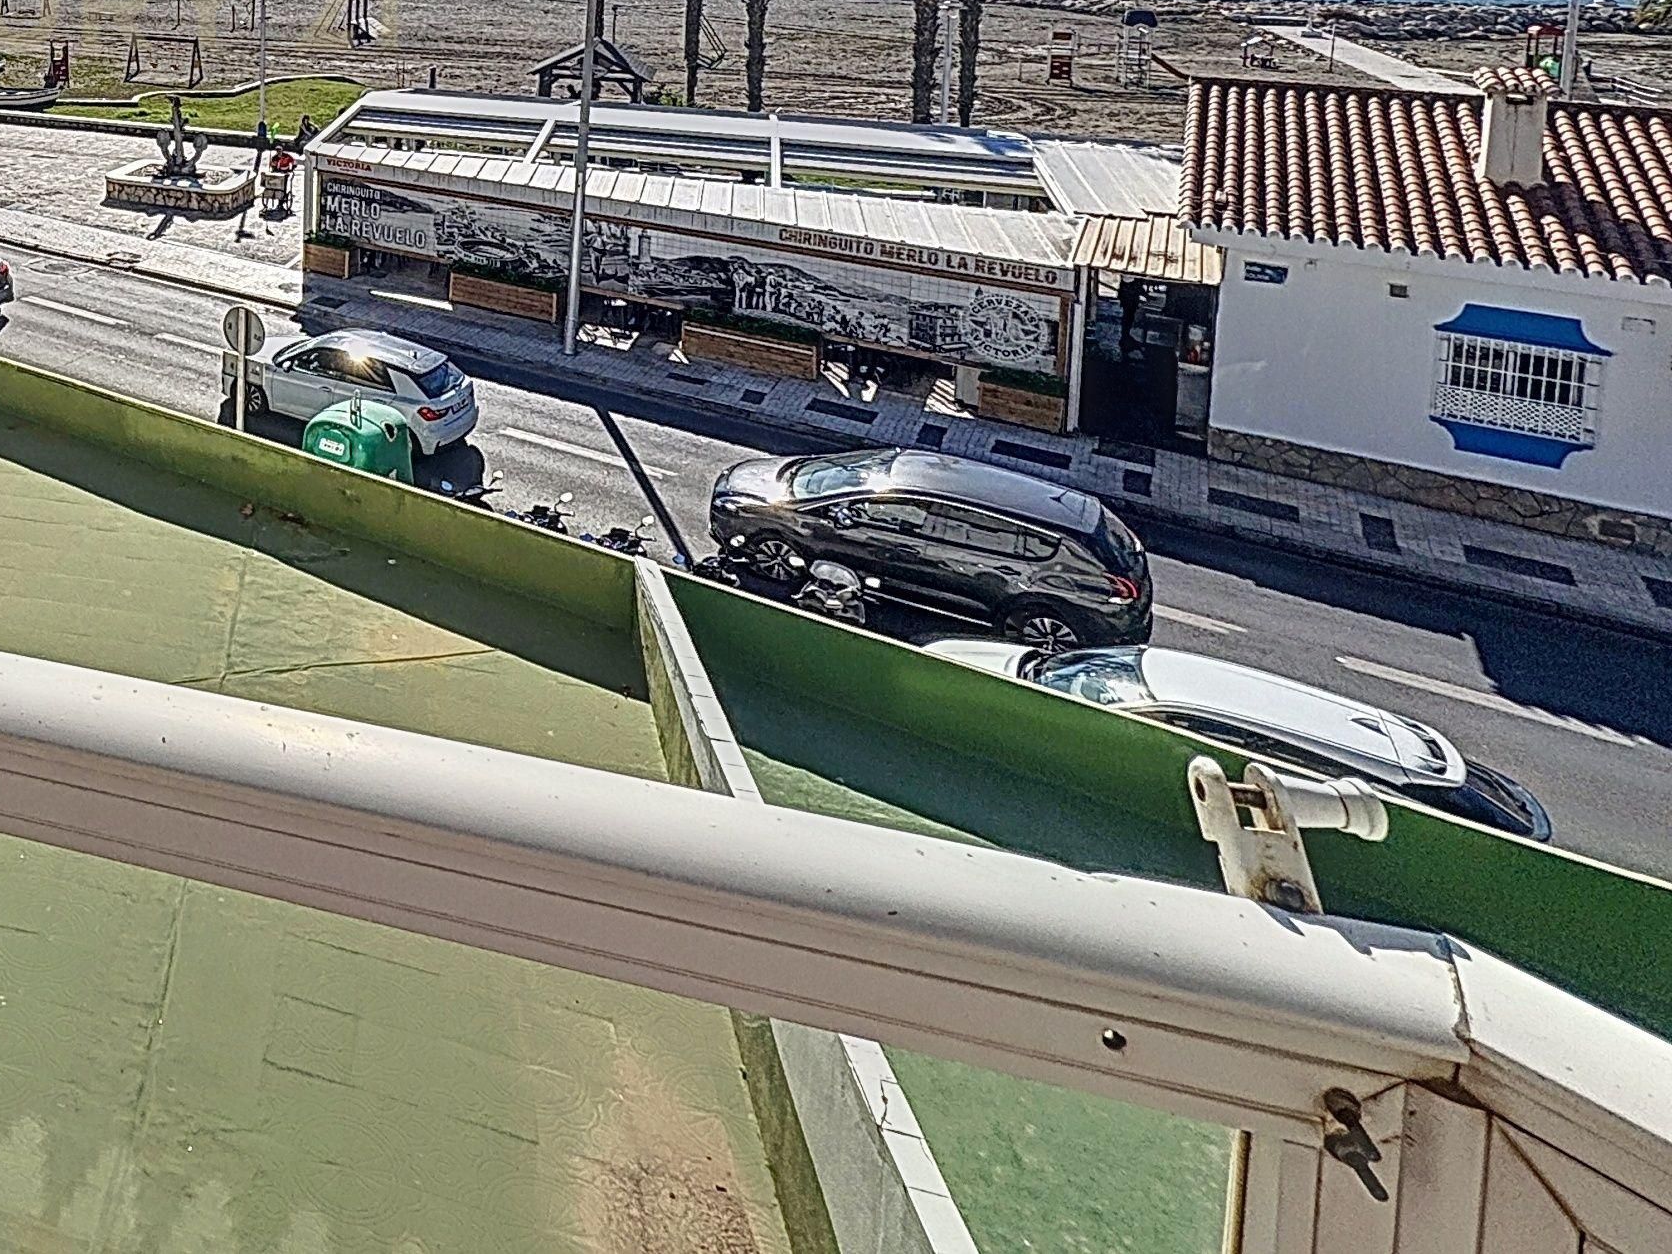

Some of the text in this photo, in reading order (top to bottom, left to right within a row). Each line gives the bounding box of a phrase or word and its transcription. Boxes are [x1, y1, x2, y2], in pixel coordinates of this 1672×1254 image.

[327, 158, 372, 172] VICTORIA
[327, 182, 381, 200] CHIRINGUITO
[326, 194, 381, 219] MERLO
[326, 214, 426, 248] LA REVUELO
[779, 228, 1057, 285] CHIRINGUITO MERLO LA REVUELO
[971, 298, 1037, 324] CERVEZAS
[973, 333, 1035, 358] VICTORIA
